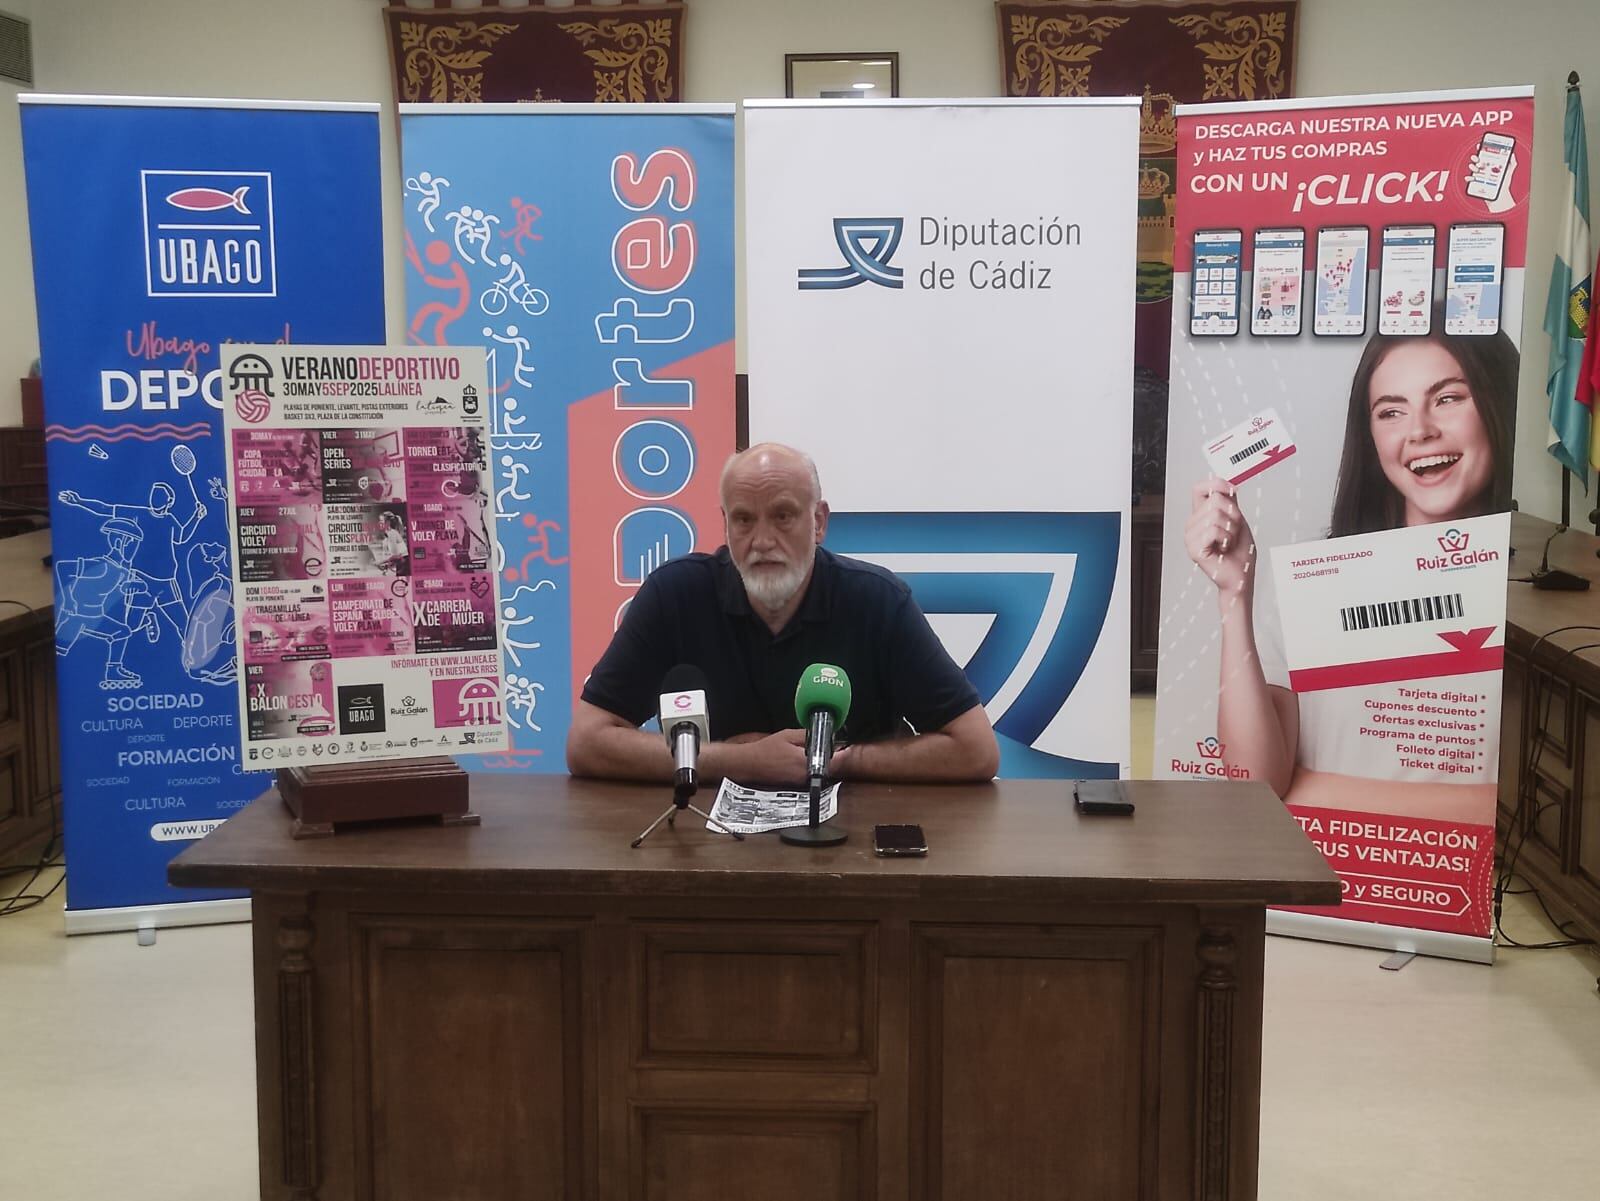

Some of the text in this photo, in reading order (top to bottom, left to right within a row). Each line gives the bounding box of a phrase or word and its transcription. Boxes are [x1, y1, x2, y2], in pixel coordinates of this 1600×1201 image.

[1195, 110, 1514, 140] DESCARGA NUESTRA NUEVA APP
[1193, 140, 1388, 167] y HAZ TUS COMPRAS
[1190, 170, 1450, 213] CON UN ¡CLICK!
[919, 215, 1081, 251] Diputación
[158, 238, 262, 284] UBAGO
[919, 260, 1051, 289] de Cádiz
[127, 320, 210, 376] Ubago
[283, 403, 302, 411] PLAYAS
[303, 403, 310, 411] DE
[323, 448, 345, 458] OPEN
[324, 458, 352, 469] SERIES
[240, 524, 277, 536] CIRCUITO
[328, 523, 363, 533] CIRCUITO
[240, 535, 267, 547] VOLEY
[1291, 550, 1374, 569] TARJETA FIDELIZADO
[1416, 555, 1449, 572] Ruiz
[1450, 549, 1499, 566] Galán
[413, 599, 473, 627] X CARRERA
[427, 611, 485, 627] DE MUJER
[429, 664, 498, 677] Y EN NUESTRAS RRSS
[430, 658, 439, 667] EN
[813, 676, 844, 687] GPON
[107, 693, 204, 712] SOCIEDAD
[1398, 688, 1478, 703] Tarjeta digital
[349, 709, 375, 723] UBAGO
[1364, 699, 1478, 717] Cupones descuento
[81, 715, 233, 733] CULTURA DEPORTE
[1372, 714, 1477, 731] Ofertas exclusivas
[127, 734, 166, 744] DEPORTE
[1359, 727, 1477, 746] Programa de puntos
[118, 743, 235, 767] FORMACIÓN
[1396, 744, 1475, 760] Folleto digital
[1171, 759, 1250, 779] Ruiz Galán
[1400, 758, 1475, 774] Ticket digital
[86, 776, 130, 787] SOCIEDAD
[125, 796, 186, 811] CULTURA
[1329, 819, 1478, 851] FIDELIZACIÓN
[1355, 846, 1470, 873] VENTAJAS!
[1354, 884, 1366, 898] y
[1370, 884, 1451, 906] SEGURO
